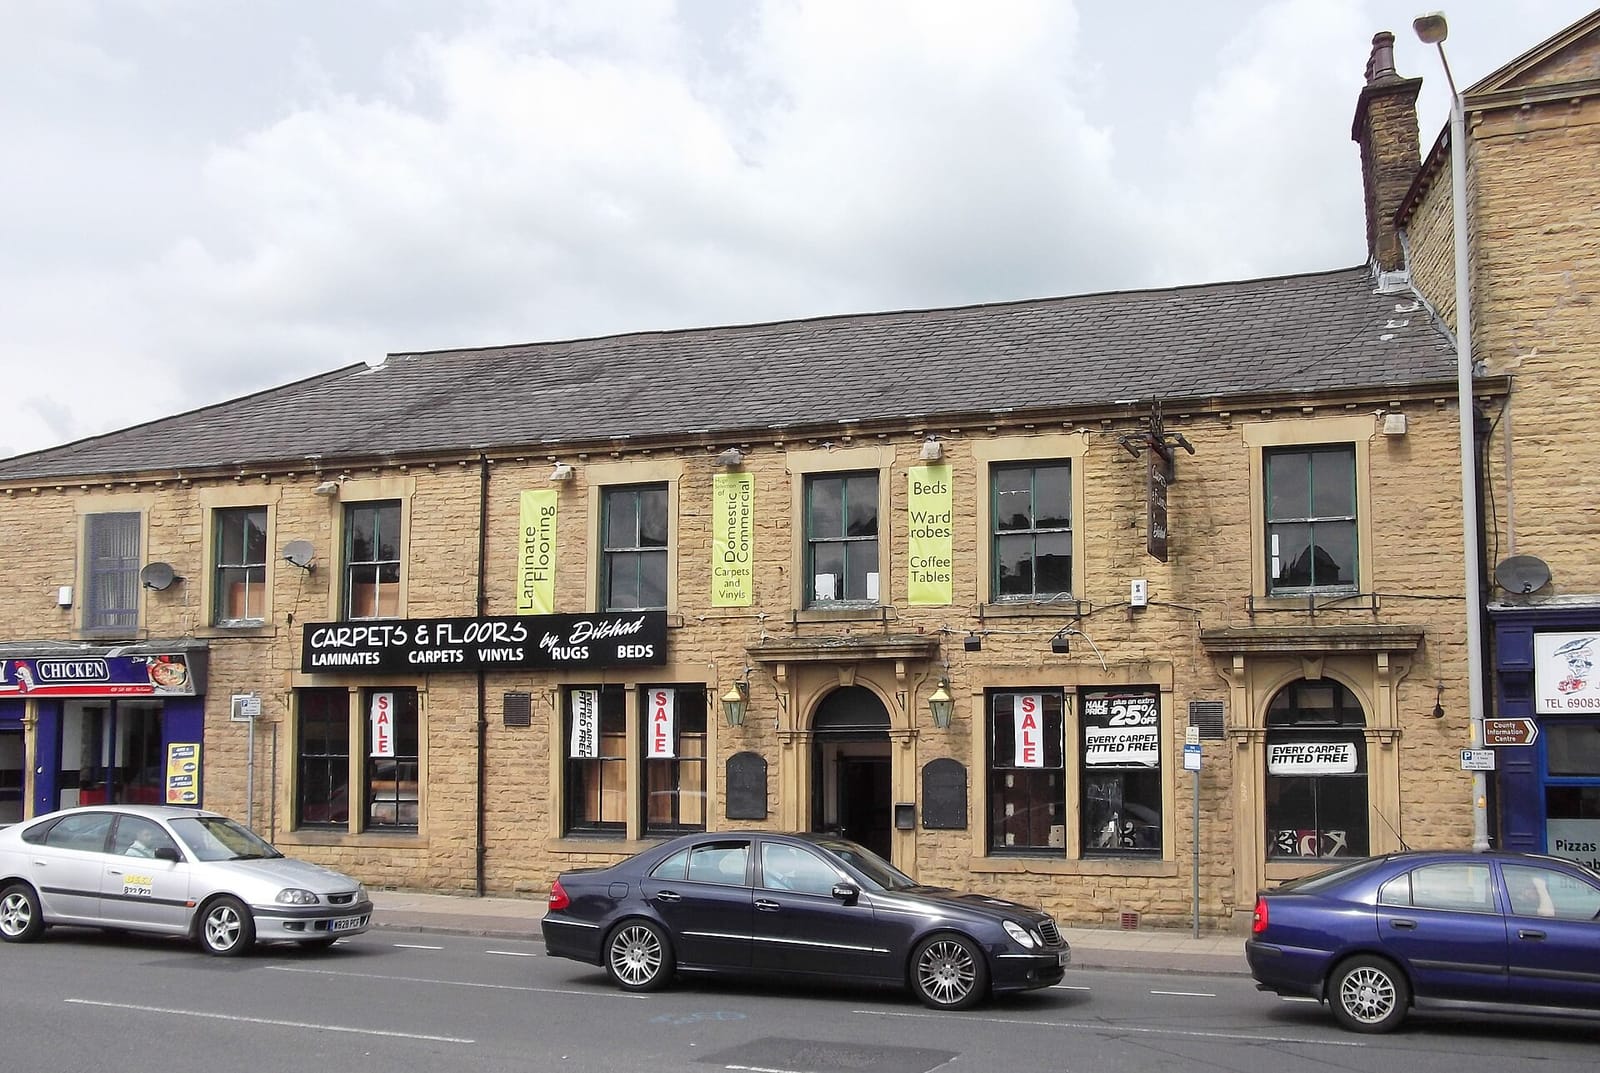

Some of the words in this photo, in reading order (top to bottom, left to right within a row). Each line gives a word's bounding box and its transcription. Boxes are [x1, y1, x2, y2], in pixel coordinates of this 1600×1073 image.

[913, 481, 947, 495] Beds
[737, 480, 750, 563] Commercial
[911, 510, 951, 524] Ward
[724, 492, 738, 563] Domestic
[911, 525, 950, 538] robes
[534, 506, 556, 581] Flooring
[520, 526, 536, 610] Laminate
[910, 556, 951, 568] Coffee
[714, 567, 750, 579] Carpets
[911, 571, 950, 583] Tables
[724, 578, 740, 588] and
[719, 590, 746, 600] Vinyls
[310, 625, 408, 648] CARPETS
[414, 625, 429, 645] &
[436, 621, 528, 646] FLOORS
[539, 631, 560, 654] by
[568, 616, 646, 645] Dilshad
[311, 652, 380, 666] LAMINATES
[408, 649, 464, 664] CARPETS
[477, 648, 525, 662] VINYLS
[552, 646, 590, 660] RUGS
[617, 644, 654, 659] BEDS
[41, 661, 105, 679] CHICKEN
[579, 691, 587, 726] FITTED
[585, 692, 593, 718] EVERY
[1086, 700, 1108, 708] HALF
[1545, 699, 1563, 708] TEL
[1085, 708, 1108, 716] PRICE
[1109, 704, 1157, 726] 25%
[377, 696, 389, 753] SALE
[654, 692, 667, 752] SALE
[1140, 717, 1157, 725] OFF
[1021, 696, 1037, 763] SALE
[1087, 735, 1117, 744] EVERY
[1119, 734, 1157, 742] CARPET
[1086, 743, 1125, 752] FITTED
[1128, 742, 1157, 751] FREE
[1273, 746, 1305, 754] EVERY
[1307, 745, 1348, 753] CARPET
[1271, 754, 1313, 764] FITTED
[1316, 753, 1348, 763] FREE
[1556, 839, 1597, 852] Pizzas
